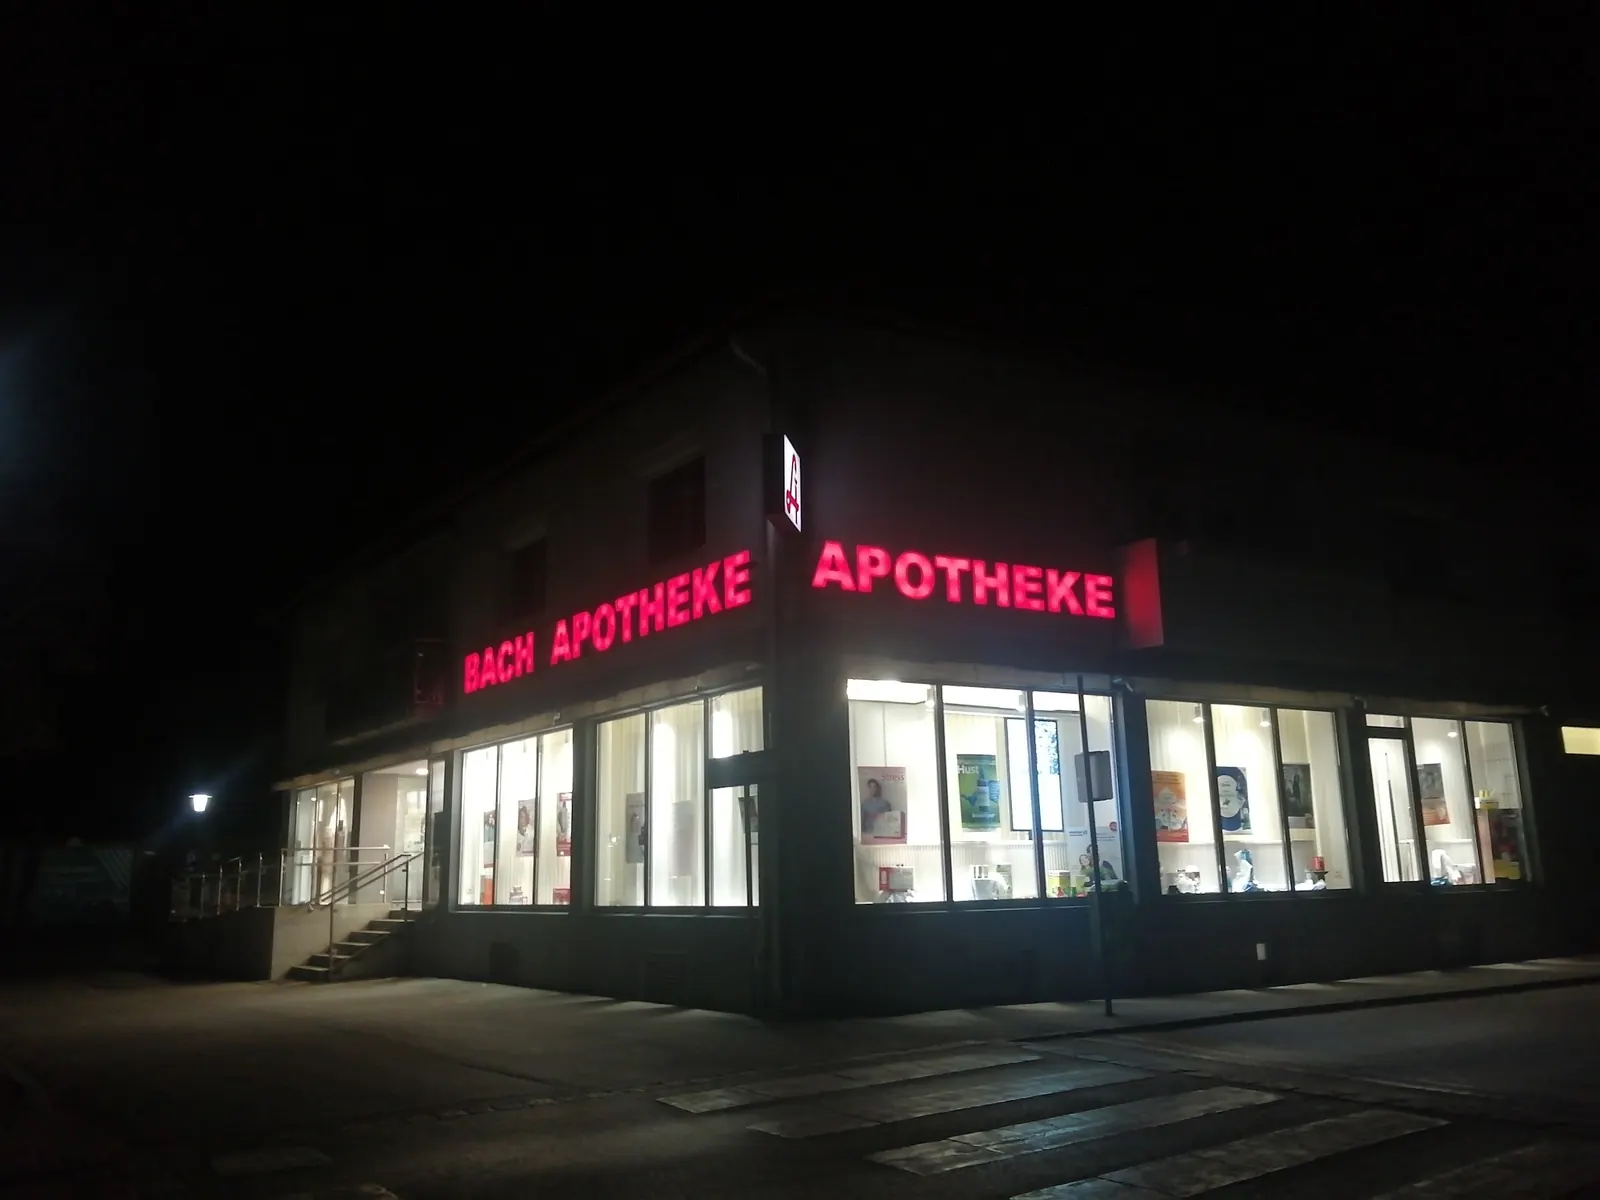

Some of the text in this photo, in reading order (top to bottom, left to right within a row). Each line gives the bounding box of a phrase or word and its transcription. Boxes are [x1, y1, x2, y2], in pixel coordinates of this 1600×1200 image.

[464, 550, 752, 694] BACH APOTHEKE
[811, 540, 1116, 619] APOTHEKE
